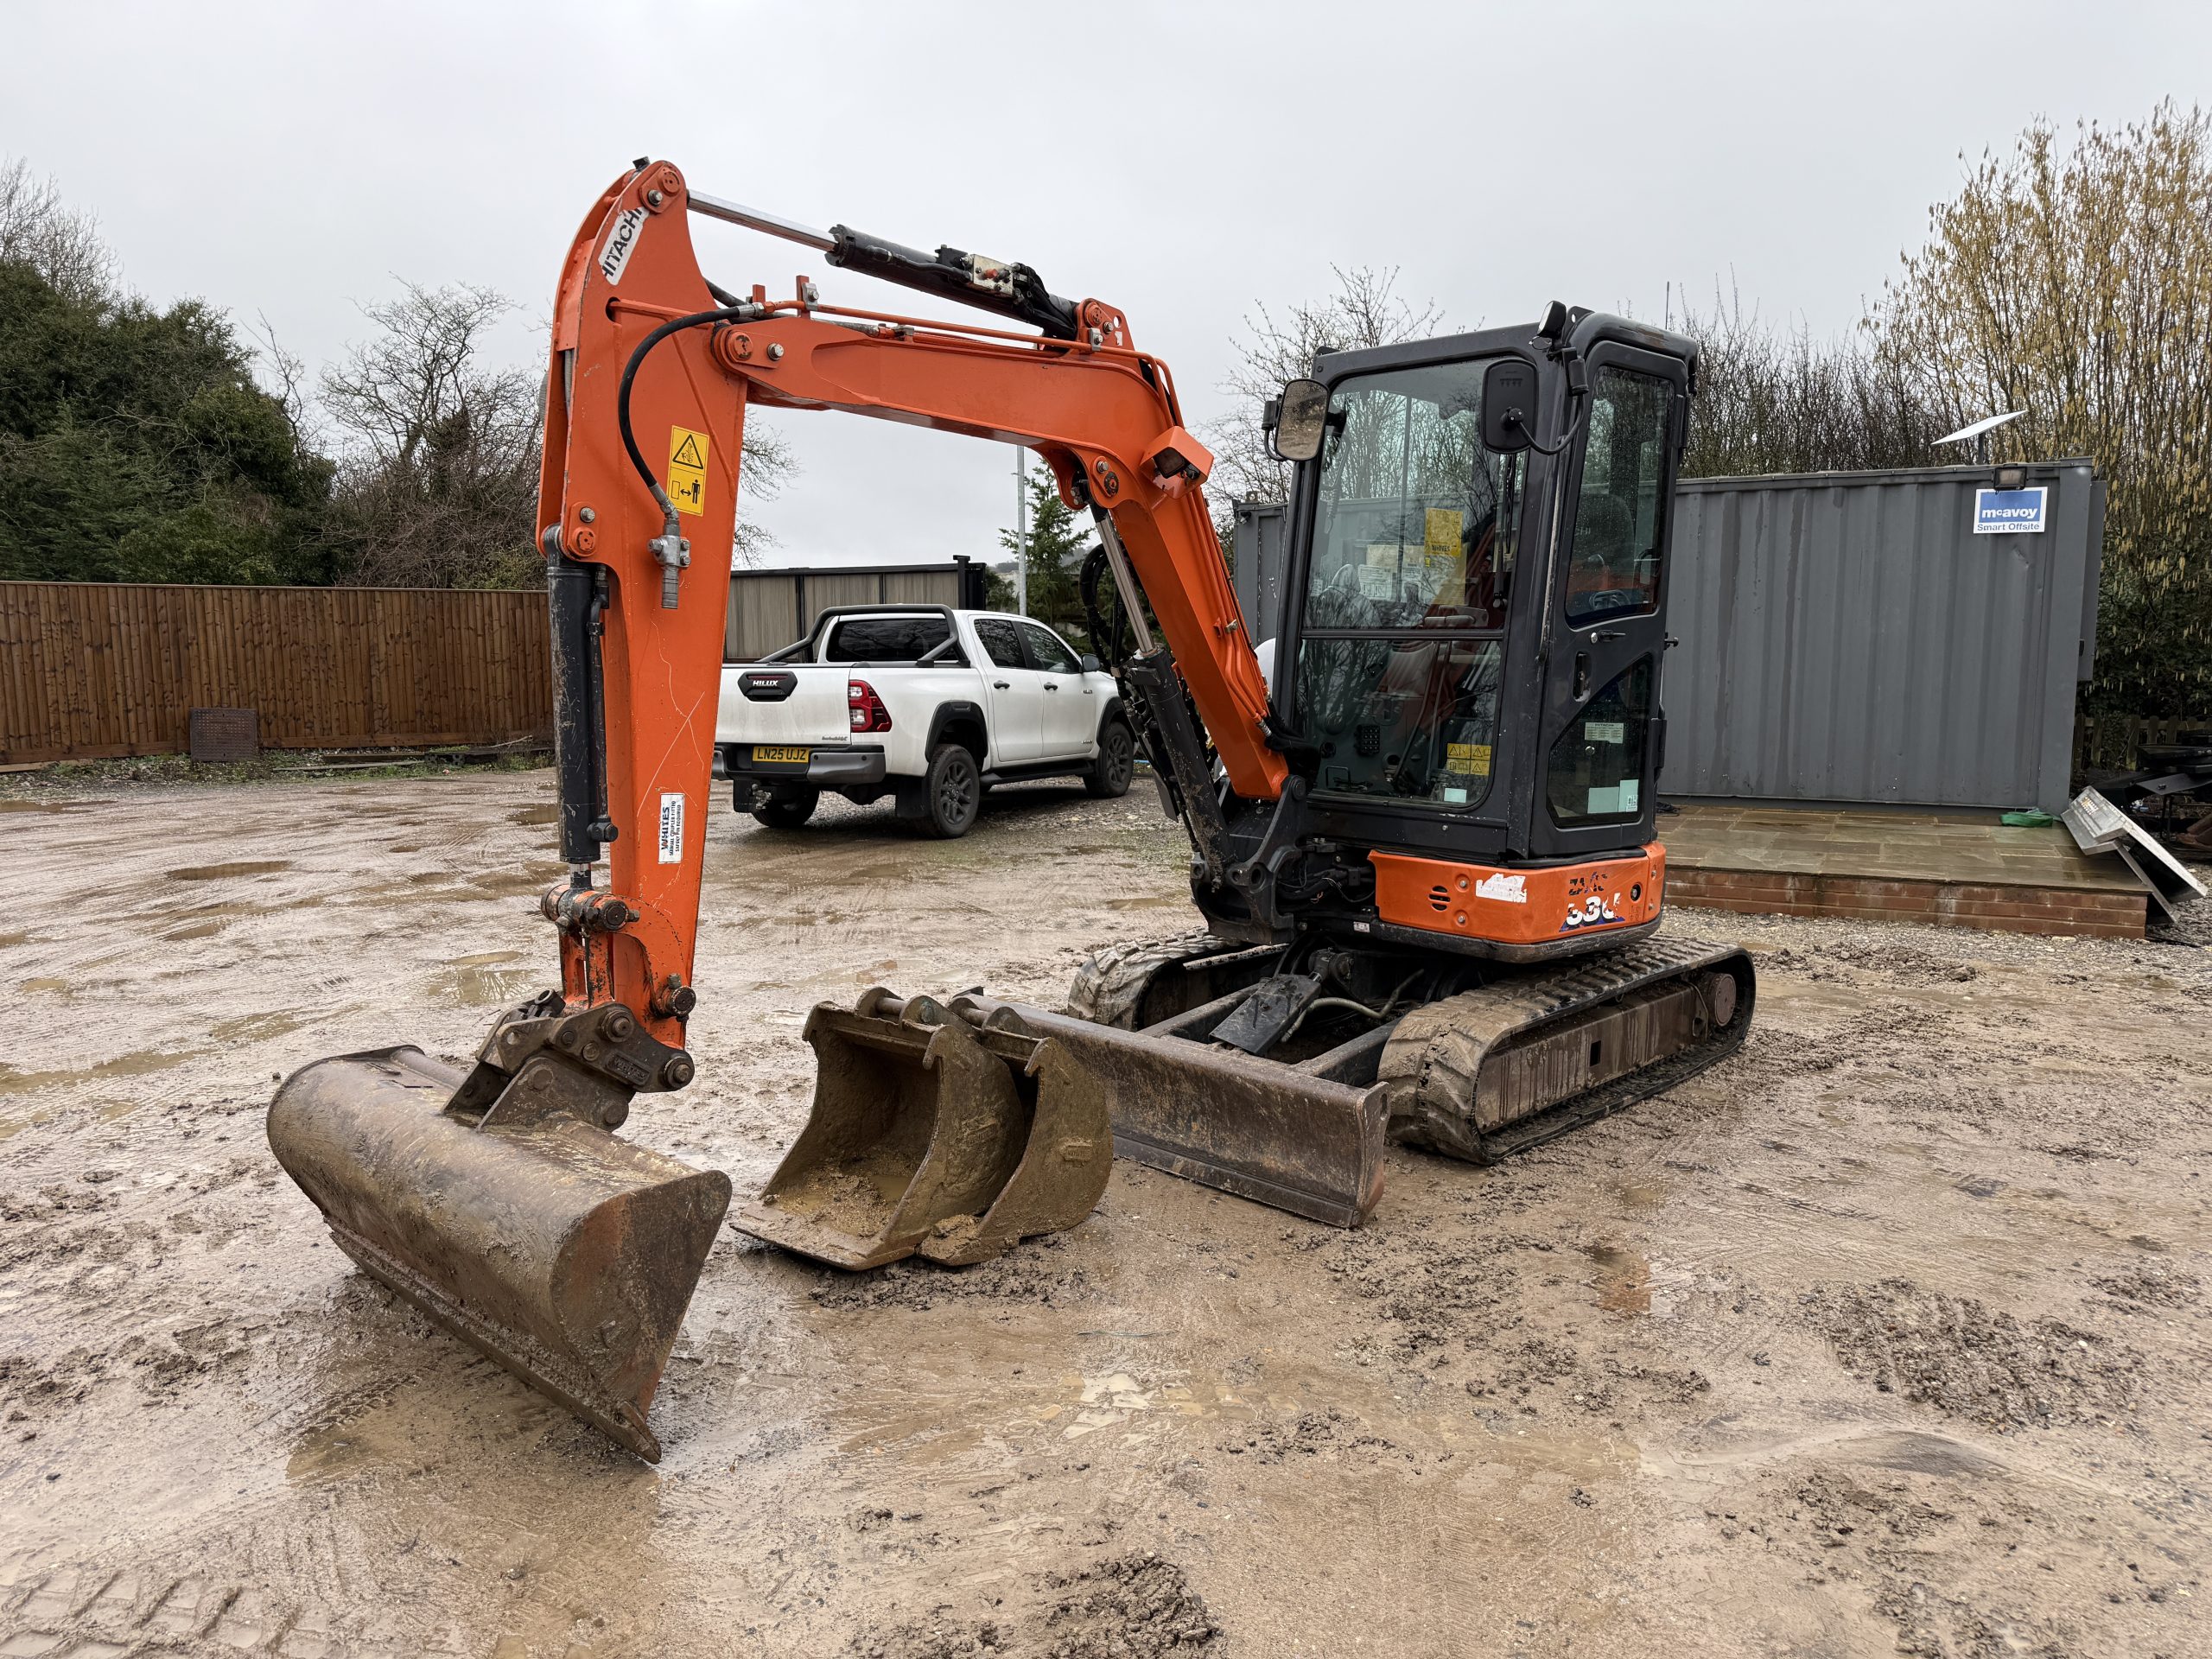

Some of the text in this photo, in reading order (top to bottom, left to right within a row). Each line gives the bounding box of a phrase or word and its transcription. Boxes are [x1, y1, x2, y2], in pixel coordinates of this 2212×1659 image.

[1977, 522, 2040, 531] Smart Offsite
[757, 748, 807, 760] LN25 UJZ
[661, 806, 671, 850] WHITES
